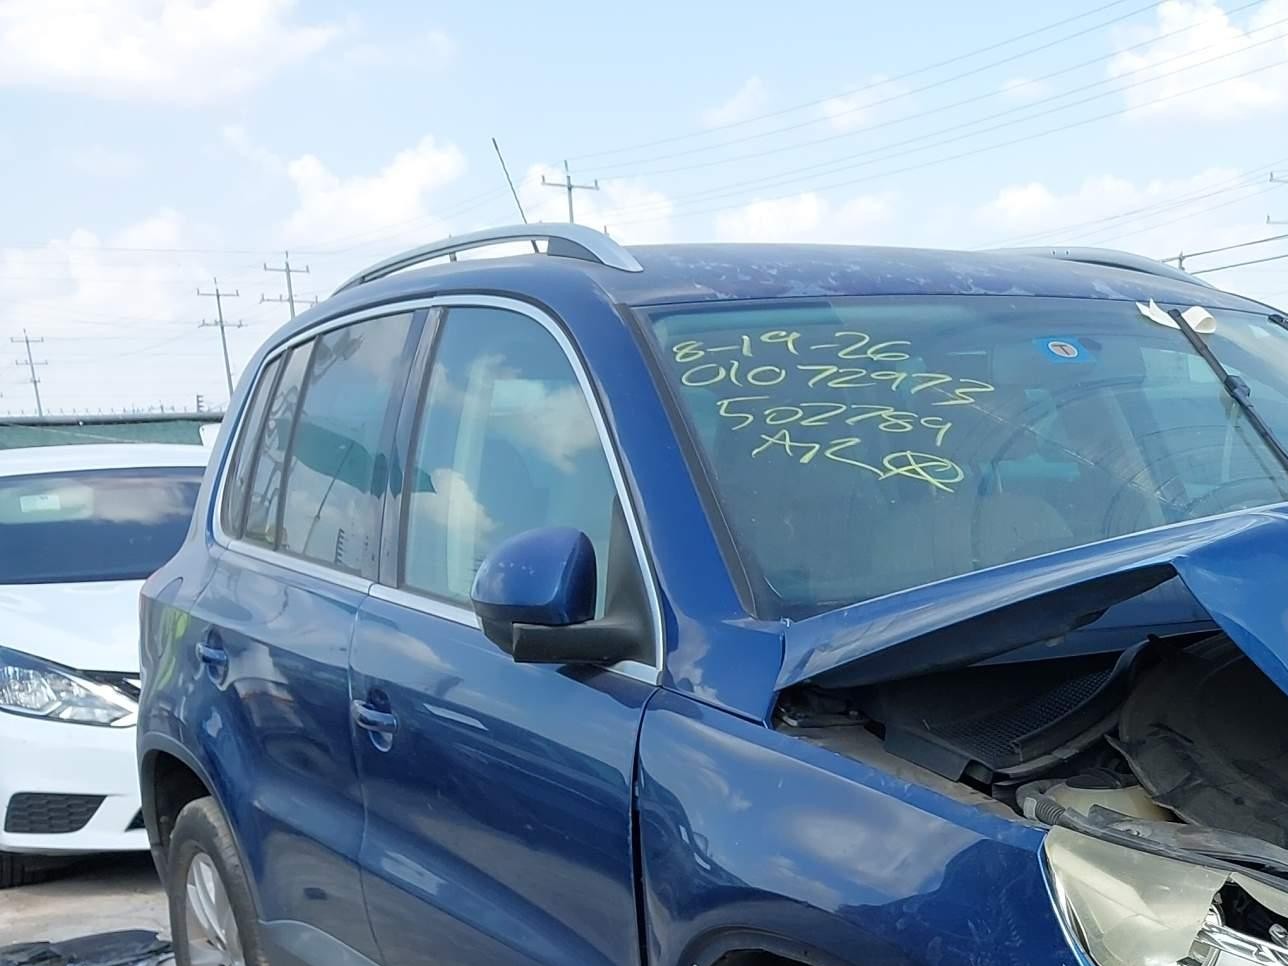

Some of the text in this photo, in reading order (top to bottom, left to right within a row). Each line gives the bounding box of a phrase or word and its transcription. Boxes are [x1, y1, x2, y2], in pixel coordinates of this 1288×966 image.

[673, 330, 912, 363] 8-19-26
[680, 359, 995, 406] 01072973
[716, 395, 952, 446] 502789
